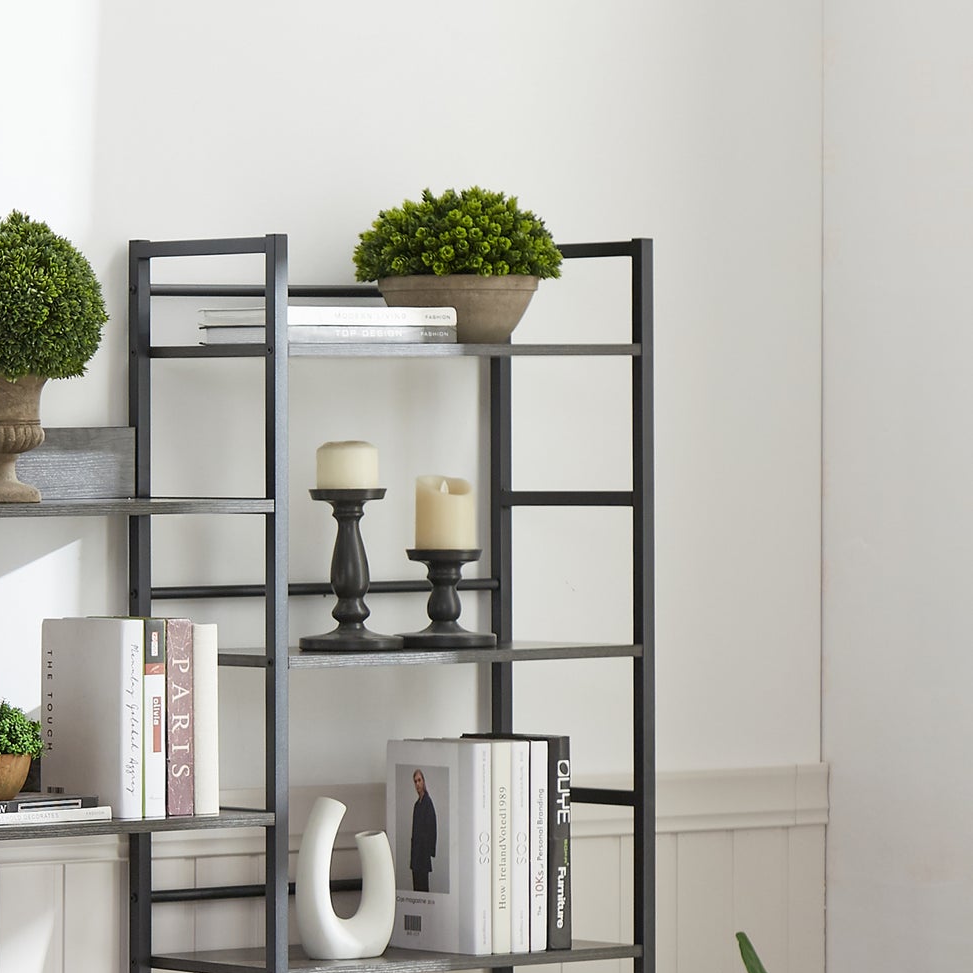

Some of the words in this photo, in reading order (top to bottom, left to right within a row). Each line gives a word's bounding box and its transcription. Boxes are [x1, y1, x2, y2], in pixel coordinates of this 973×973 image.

[335, 329, 357, 337] TOP
[362, 329, 403, 337] DESIGN
[153, 698, 161, 725] olivia
[171, 656, 190, 778] PARIS
[536, 788, 544, 825] Branding
[499, 885, 507, 909] How
[535, 870, 544, 898] 10Ks
[556, 866, 567, 929] Furniture
